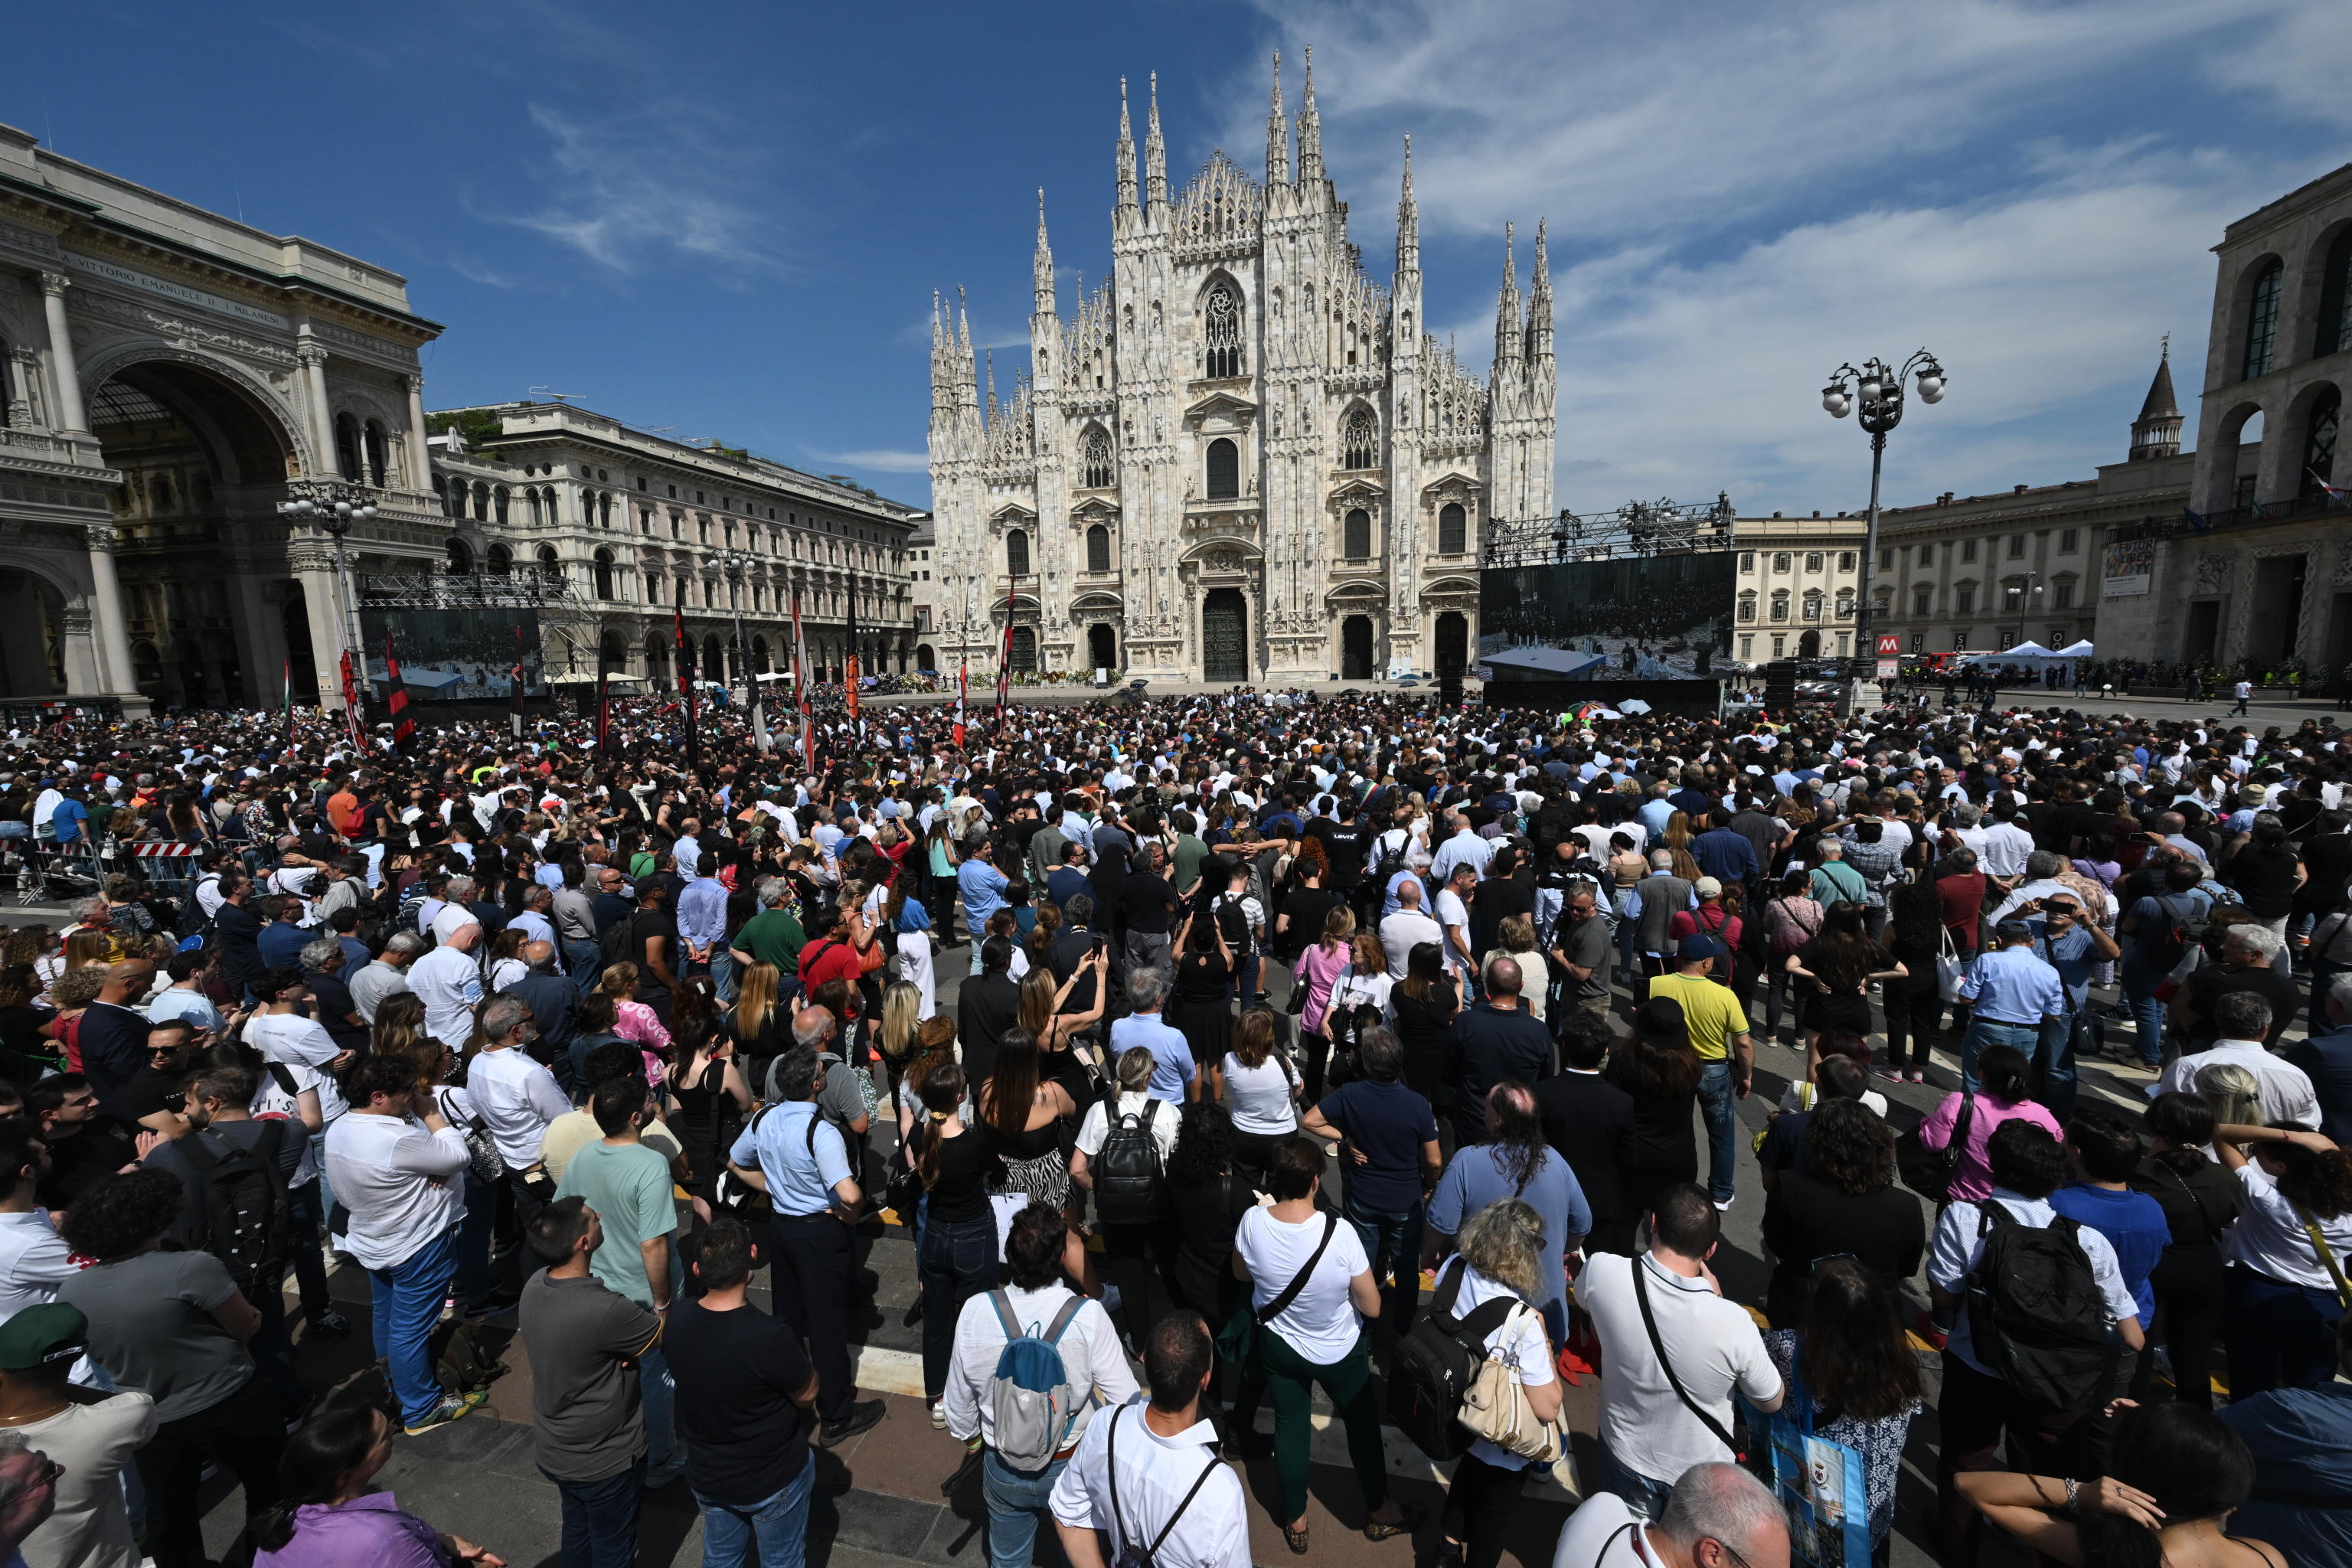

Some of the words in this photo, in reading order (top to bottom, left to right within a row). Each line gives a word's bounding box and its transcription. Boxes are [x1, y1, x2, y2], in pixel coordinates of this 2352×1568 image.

[78, 258, 135, 282] VITTORIO
[141, 277, 202, 302] EMANUELE
[234, 305, 279, 325] MILANESI
[1879, 639, 1898, 651] M
